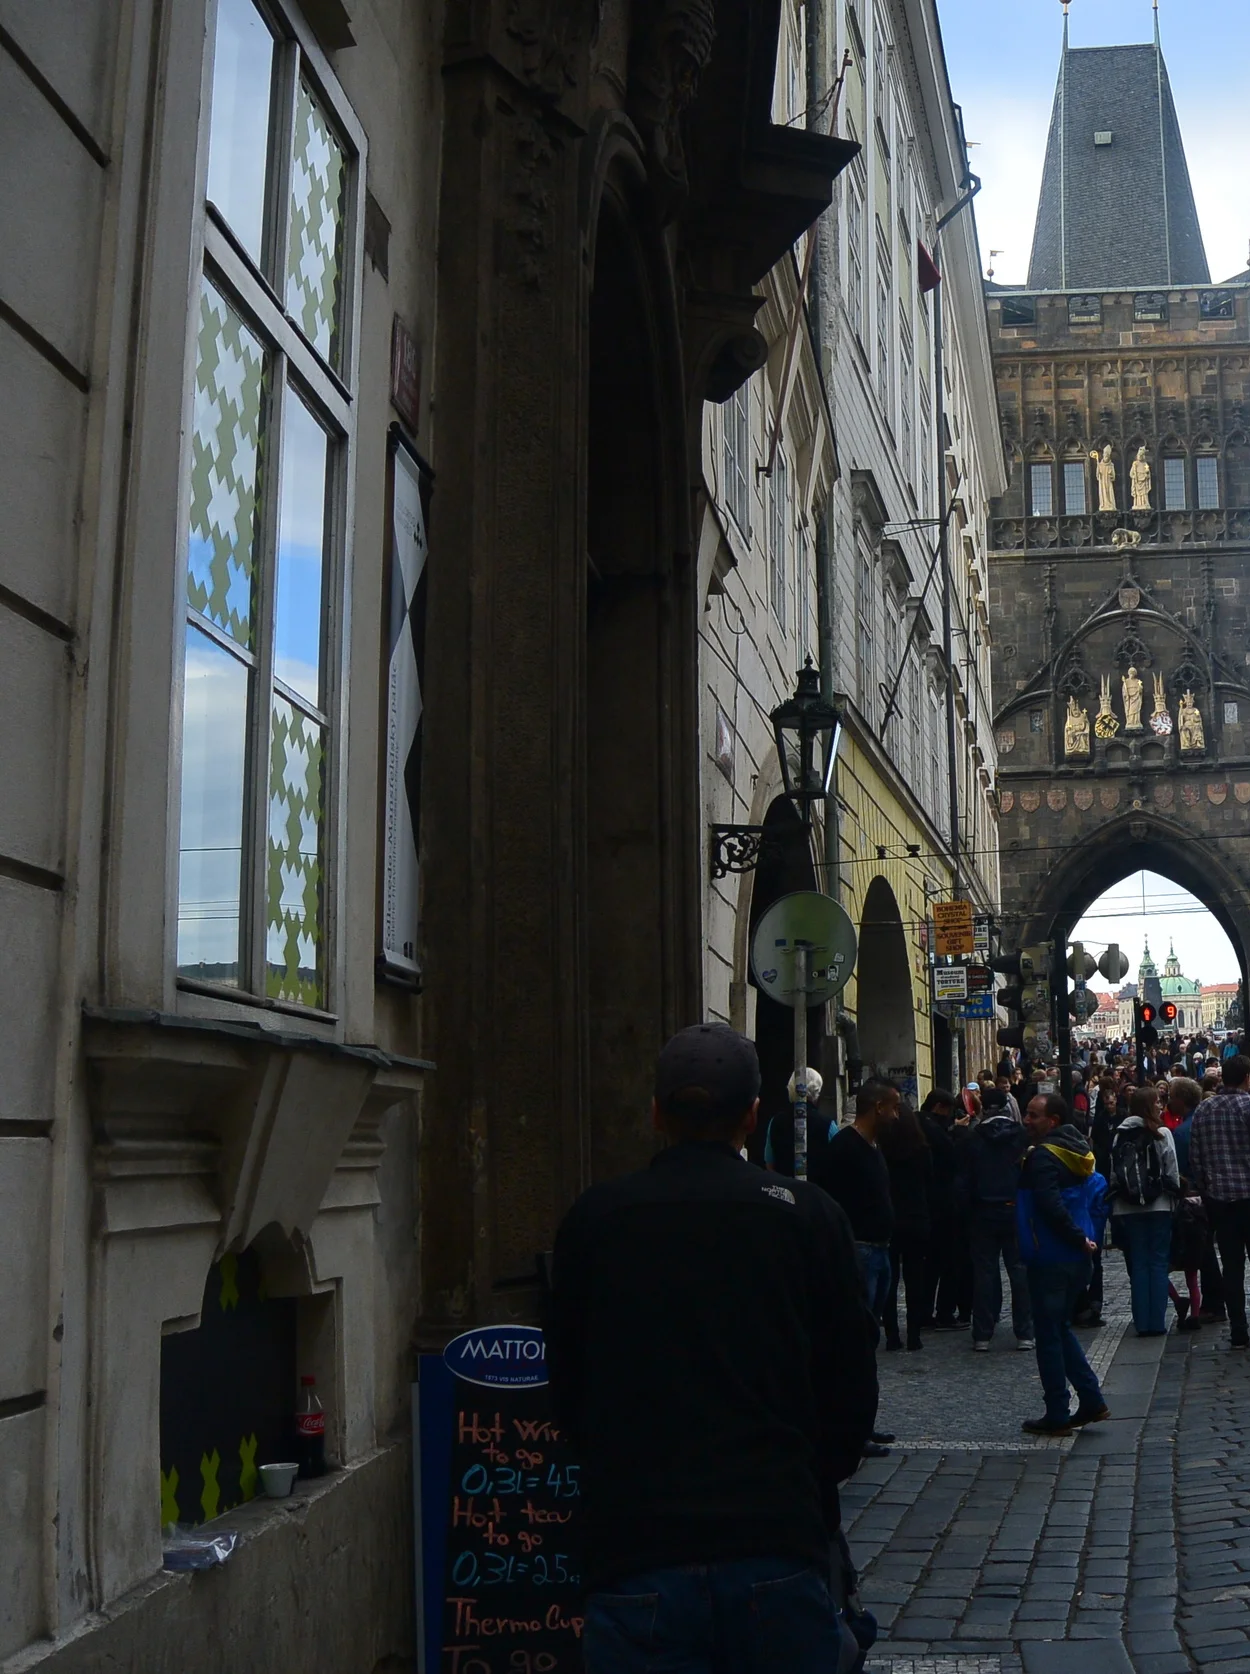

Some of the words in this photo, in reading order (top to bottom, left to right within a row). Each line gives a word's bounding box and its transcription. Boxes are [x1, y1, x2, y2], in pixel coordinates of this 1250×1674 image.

[1167, 1006, 1175, 1017] 9
[510, 1374, 539, 1382] NATURAE
[457, 1410, 506, 1444] Hot
[481, 1442, 510, 1464] to
[515, 1447, 544, 1470] go
[452, 1495, 507, 1528] Hot
[520, 1499, 573, 1524] tea
[481, 1521, 510, 1546] to
[517, 1530, 544, 1553] go
[446, 1596, 543, 1637] Thermo
[545, 1603, 584, 1639] Cup
[507, 1649, 558, 1674] go
